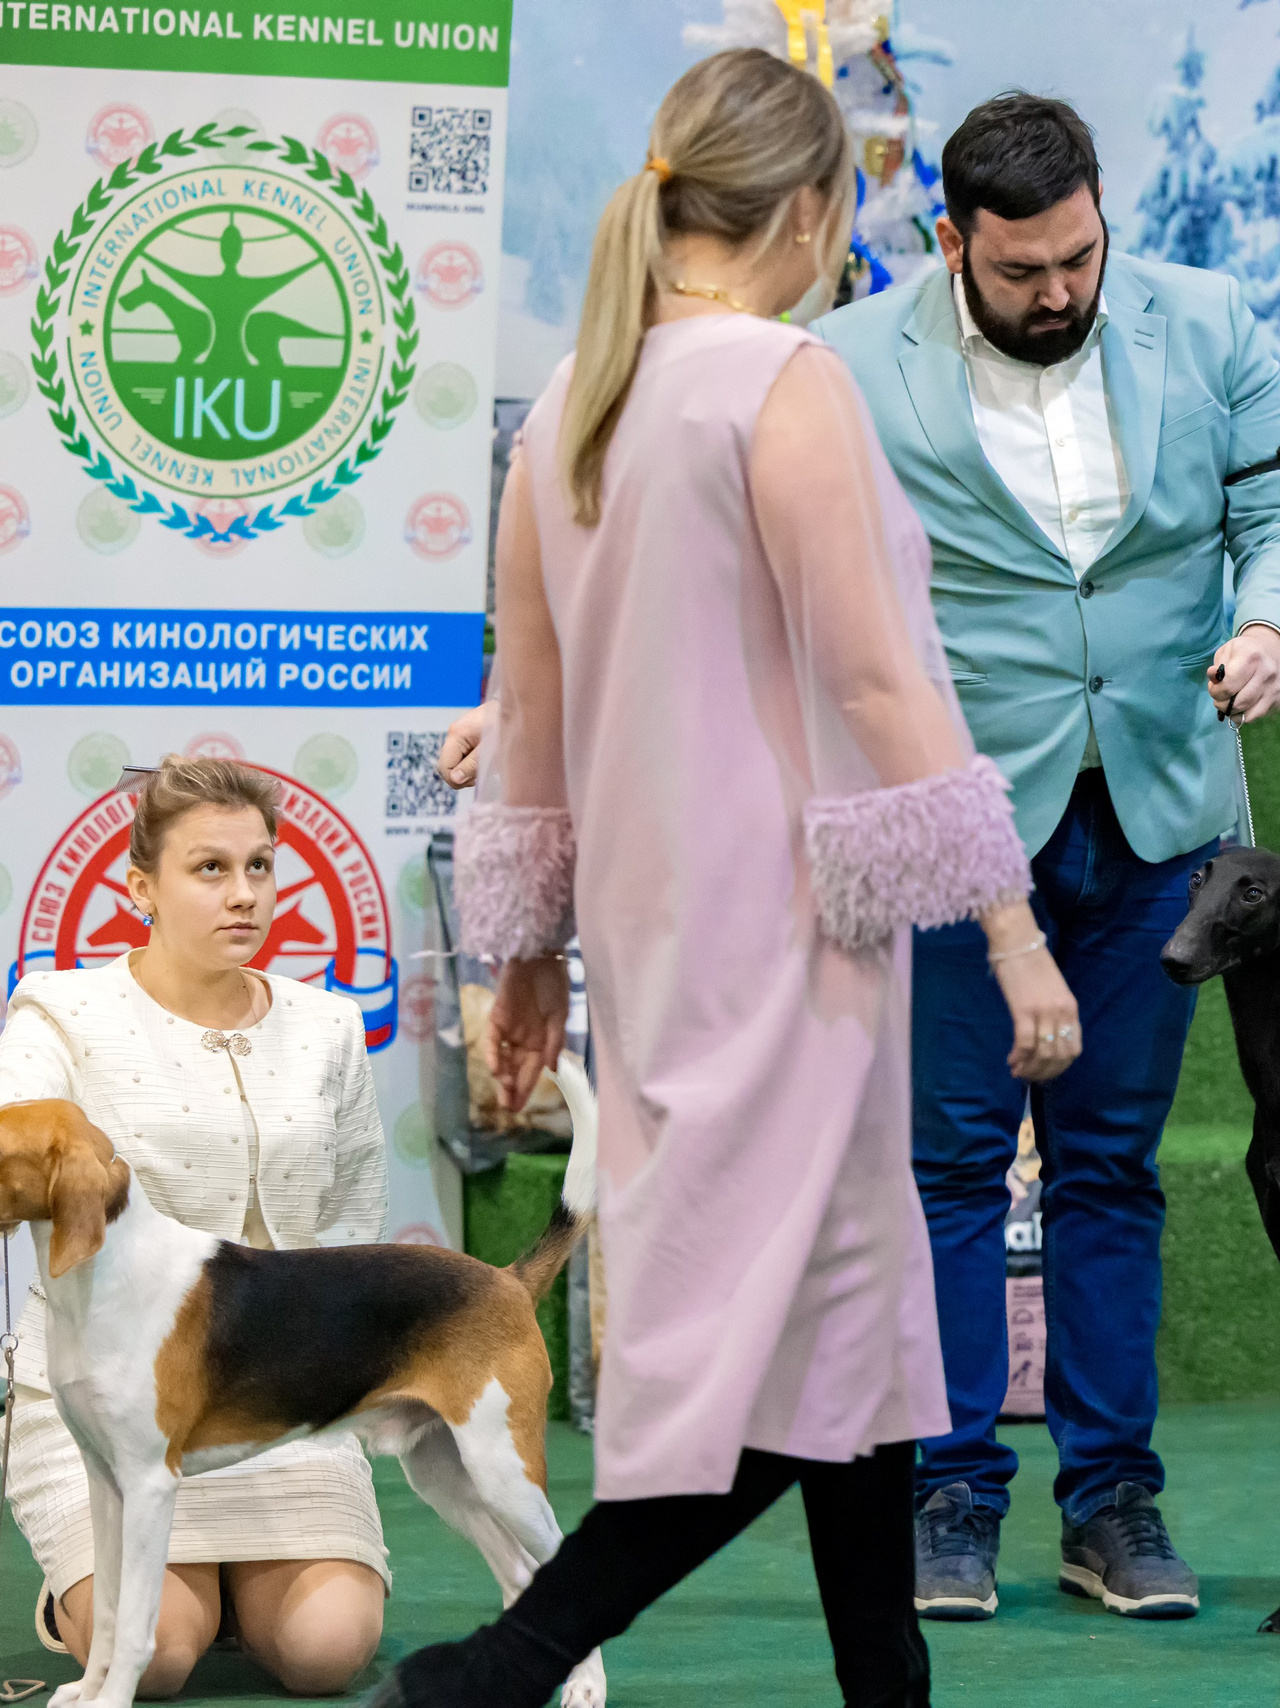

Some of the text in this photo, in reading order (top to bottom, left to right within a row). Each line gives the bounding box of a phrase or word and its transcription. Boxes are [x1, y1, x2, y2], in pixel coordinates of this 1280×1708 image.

[0, 2, 499, 52] TERNATIONAL KENNEL UNION
[81, 178, 373, 315] INTERNATIONAL KENNEL UNION
[80, 351, 371, 487] INTERNATIONAL KENNEL UNION
[174, 377, 281, 440] IKU
[0, 620, 428, 652] СОЮЗ КИНОЛОГИЧЕСКИХ
[11, 657, 411, 693] ОРГАНИЗАЦИЙ РОССИИ
[31, 882, 67, 942] СОЮЗ
[343, 861, 381, 940] РОССИИ
